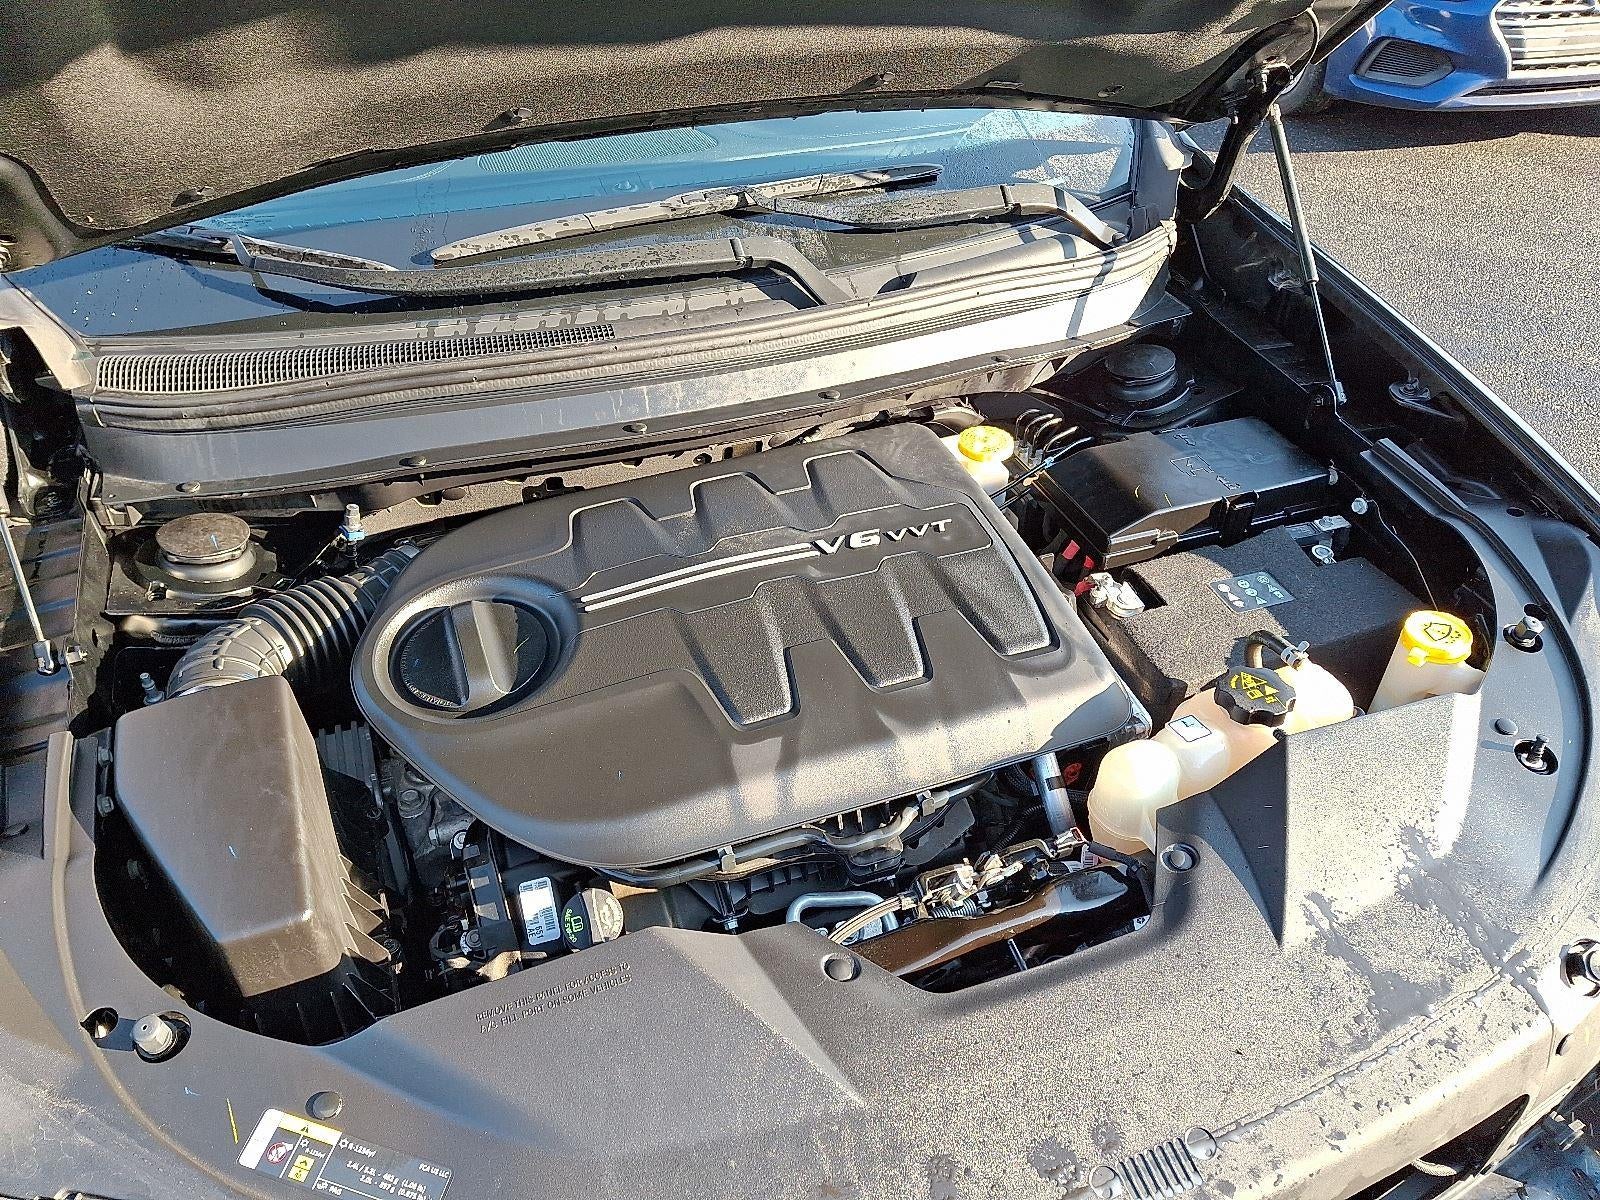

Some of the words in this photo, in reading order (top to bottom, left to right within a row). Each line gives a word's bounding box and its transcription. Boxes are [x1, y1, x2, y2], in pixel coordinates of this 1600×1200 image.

[812, 528, 881, 555] V6
[884, 518, 952, 542] VVT
[564, 908, 573, 923] SAE
[475, 1003, 514, 1022] REMOVE
[513, 994, 535, 1009] THIS
[535, 985, 564, 1001] PANEL
[564, 978, 583, 991] FOR
[583, 966, 618, 985] ACCESS
[618, 961, 631, 972] TO
[500, 1012, 521, 1027] FILL
[521, 1004, 546, 1019] PORT
[547, 998, 561, 1010] ON
[561, 988, 589, 1005] SOME
[590, 973, 633, 995] VEHICLES
